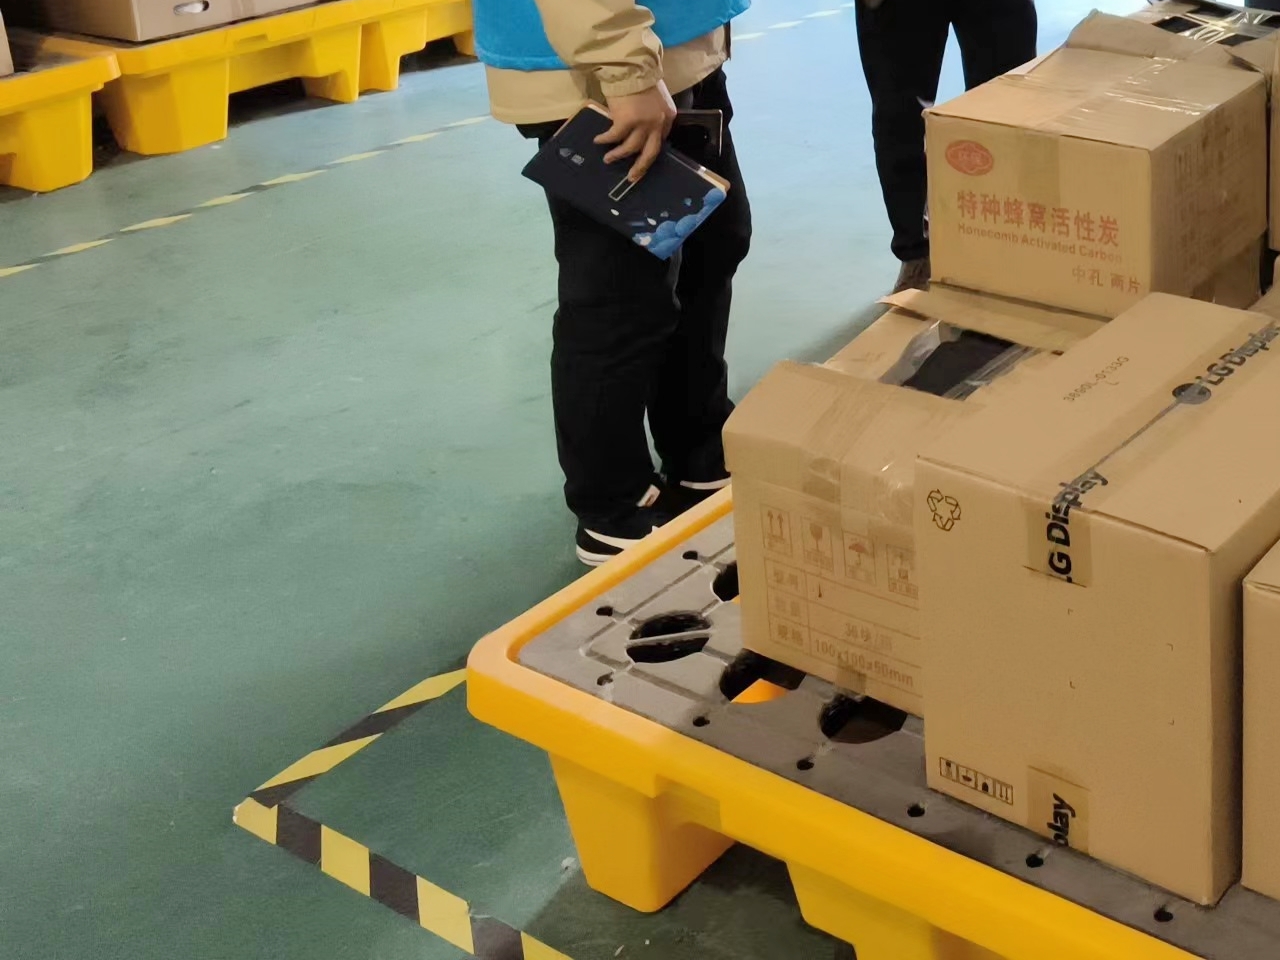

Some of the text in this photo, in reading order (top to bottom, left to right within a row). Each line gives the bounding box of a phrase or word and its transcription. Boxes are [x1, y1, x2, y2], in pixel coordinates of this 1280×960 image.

[956, 190, 1120, 248] 特种蜂窝活性炭
[958, 222, 1123, 263] Honecomb Activated Carbon
[1072, 265, 1104, 287] 中孔
[1195, 362, 1235, 386] LG
[1045, 468, 1109, 583] G Display
